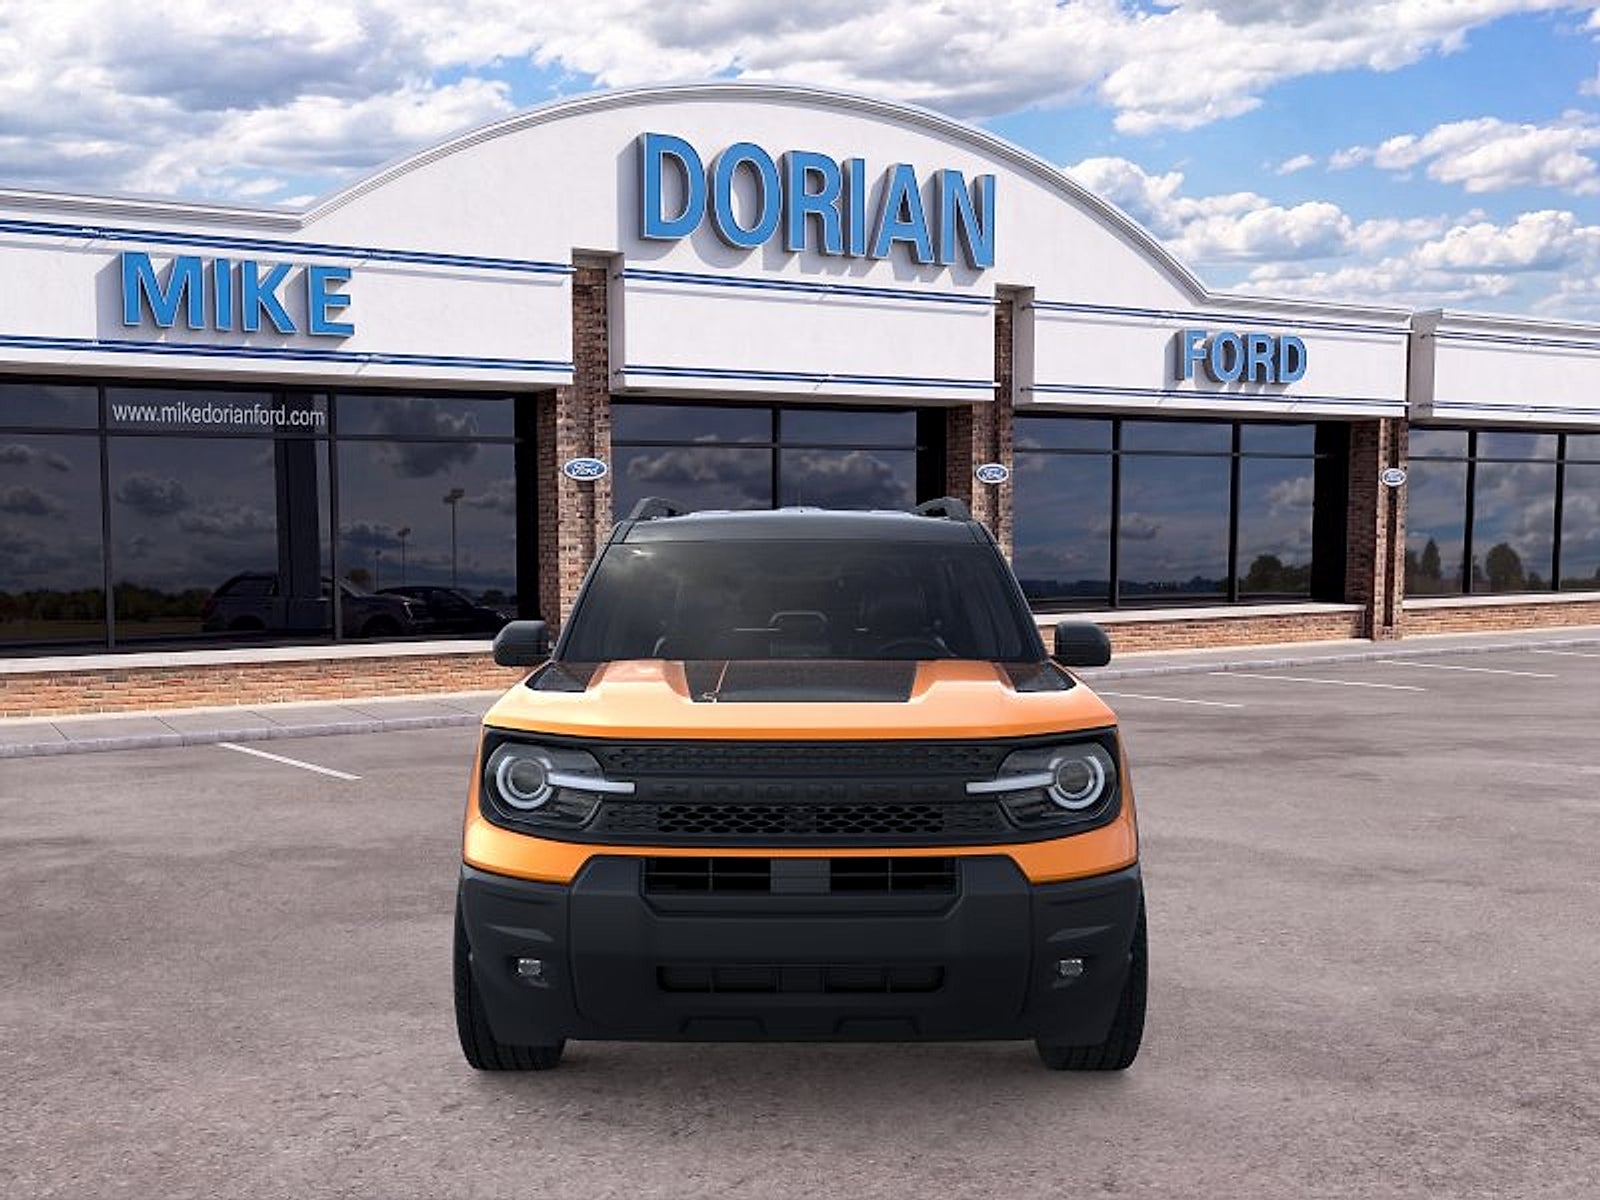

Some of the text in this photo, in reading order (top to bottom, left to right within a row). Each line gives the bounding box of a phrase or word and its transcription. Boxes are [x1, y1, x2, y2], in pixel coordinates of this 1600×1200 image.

[640, 132, 996, 269] DORIAN
[121, 251, 355, 337] MIKE
[1178, 328, 1308, 384] FORD
[112, 401, 326, 426] www.mikedorianford.com
